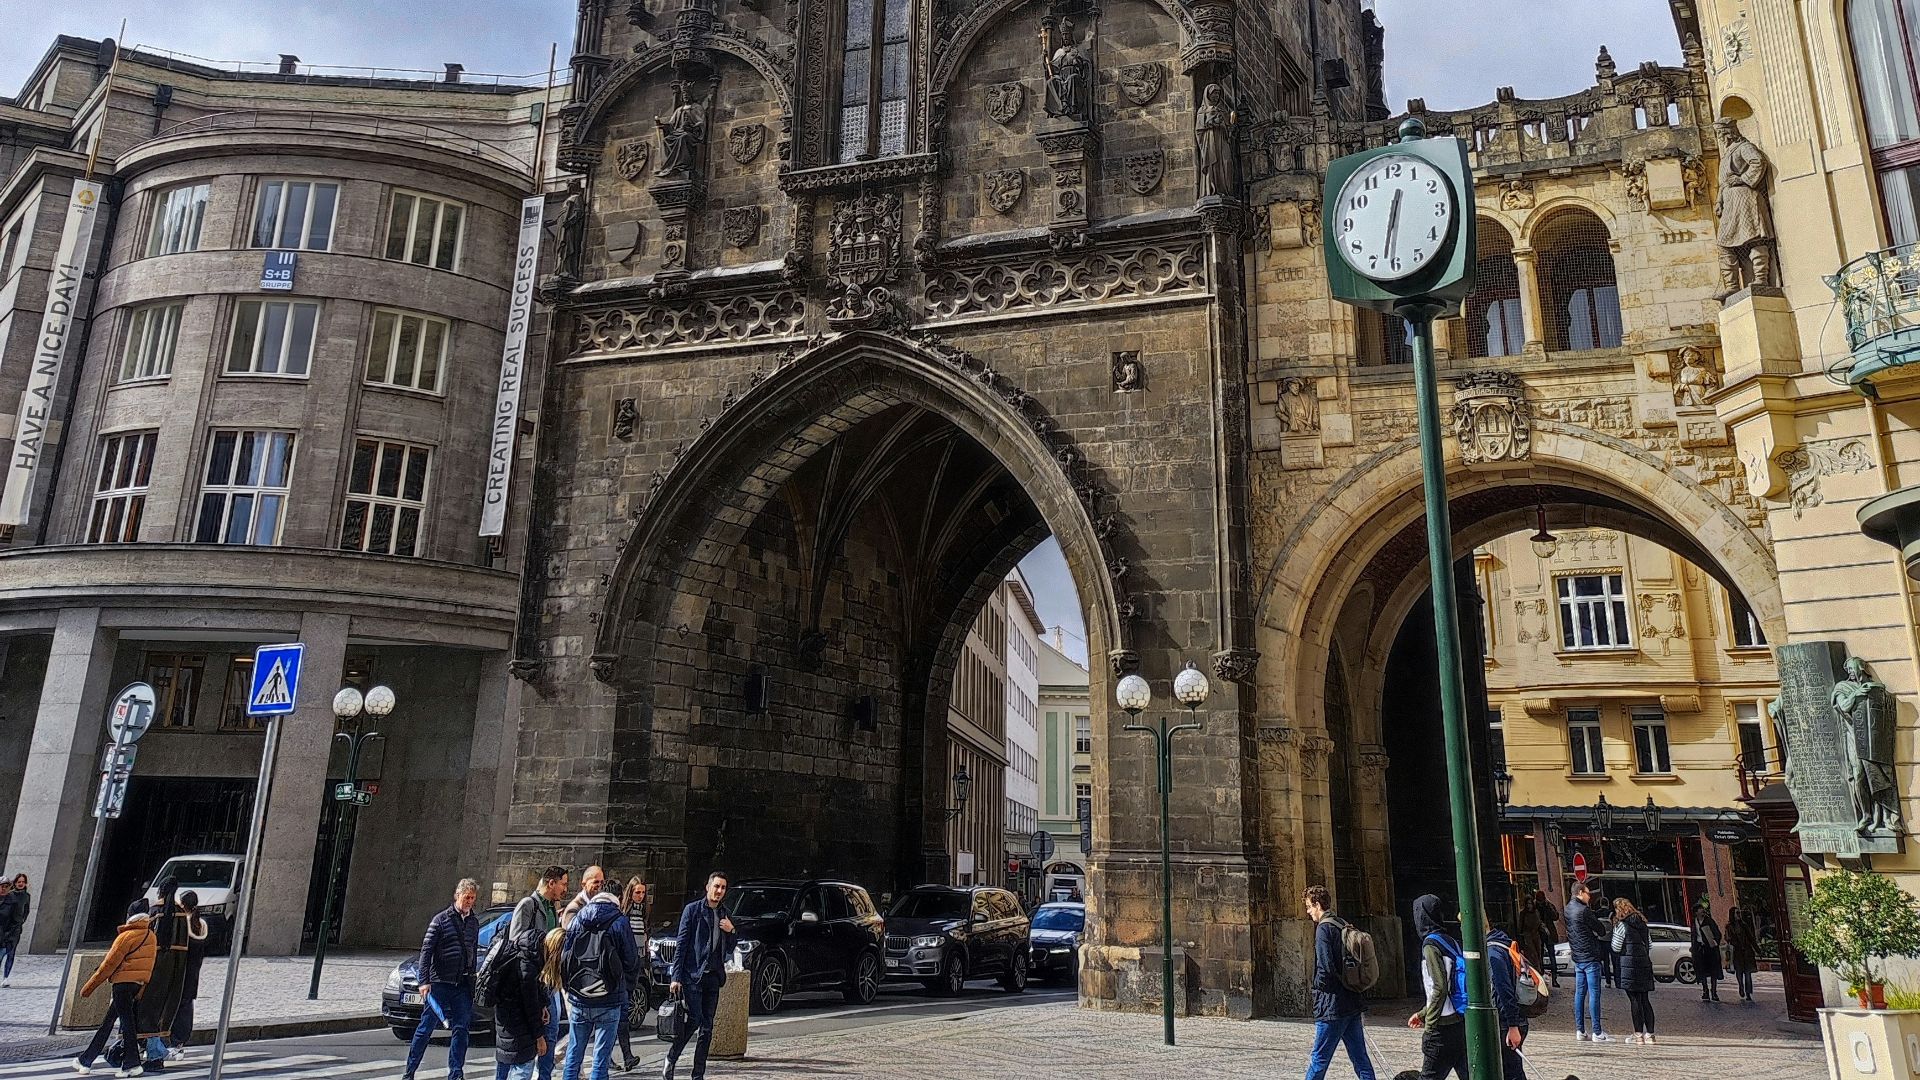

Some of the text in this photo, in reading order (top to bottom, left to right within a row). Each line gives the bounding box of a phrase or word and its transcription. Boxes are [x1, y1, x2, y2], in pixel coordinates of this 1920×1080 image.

[1384, 164, 1402, 180] 12
[1410, 166, 1418, 181] 1
[1364, 175, 1379, 190] 11
[1426, 180, 1437, 195] 2
[1350, 195, 1368, 211] 10
[1435, 202, 1446, 217] 3
[1343, 218, 1354, 233] 9
[1427, 225, 1438, 242] 4
[1351, 240, 1362, 254] 8
[1369, 254, 1378, 270] 7
[1413, 248, 1424, 263] 5
[1391, 257, 1401, 272] 6
[264, 269, 291, 279] S+B
[16, 263, 79, 470] HAVE A NICE DAY!
[487, 400, 513, 504] CREATING
[501, 339, 521, 392] REAL
[511, 245, 535, 334] SUCCESS
